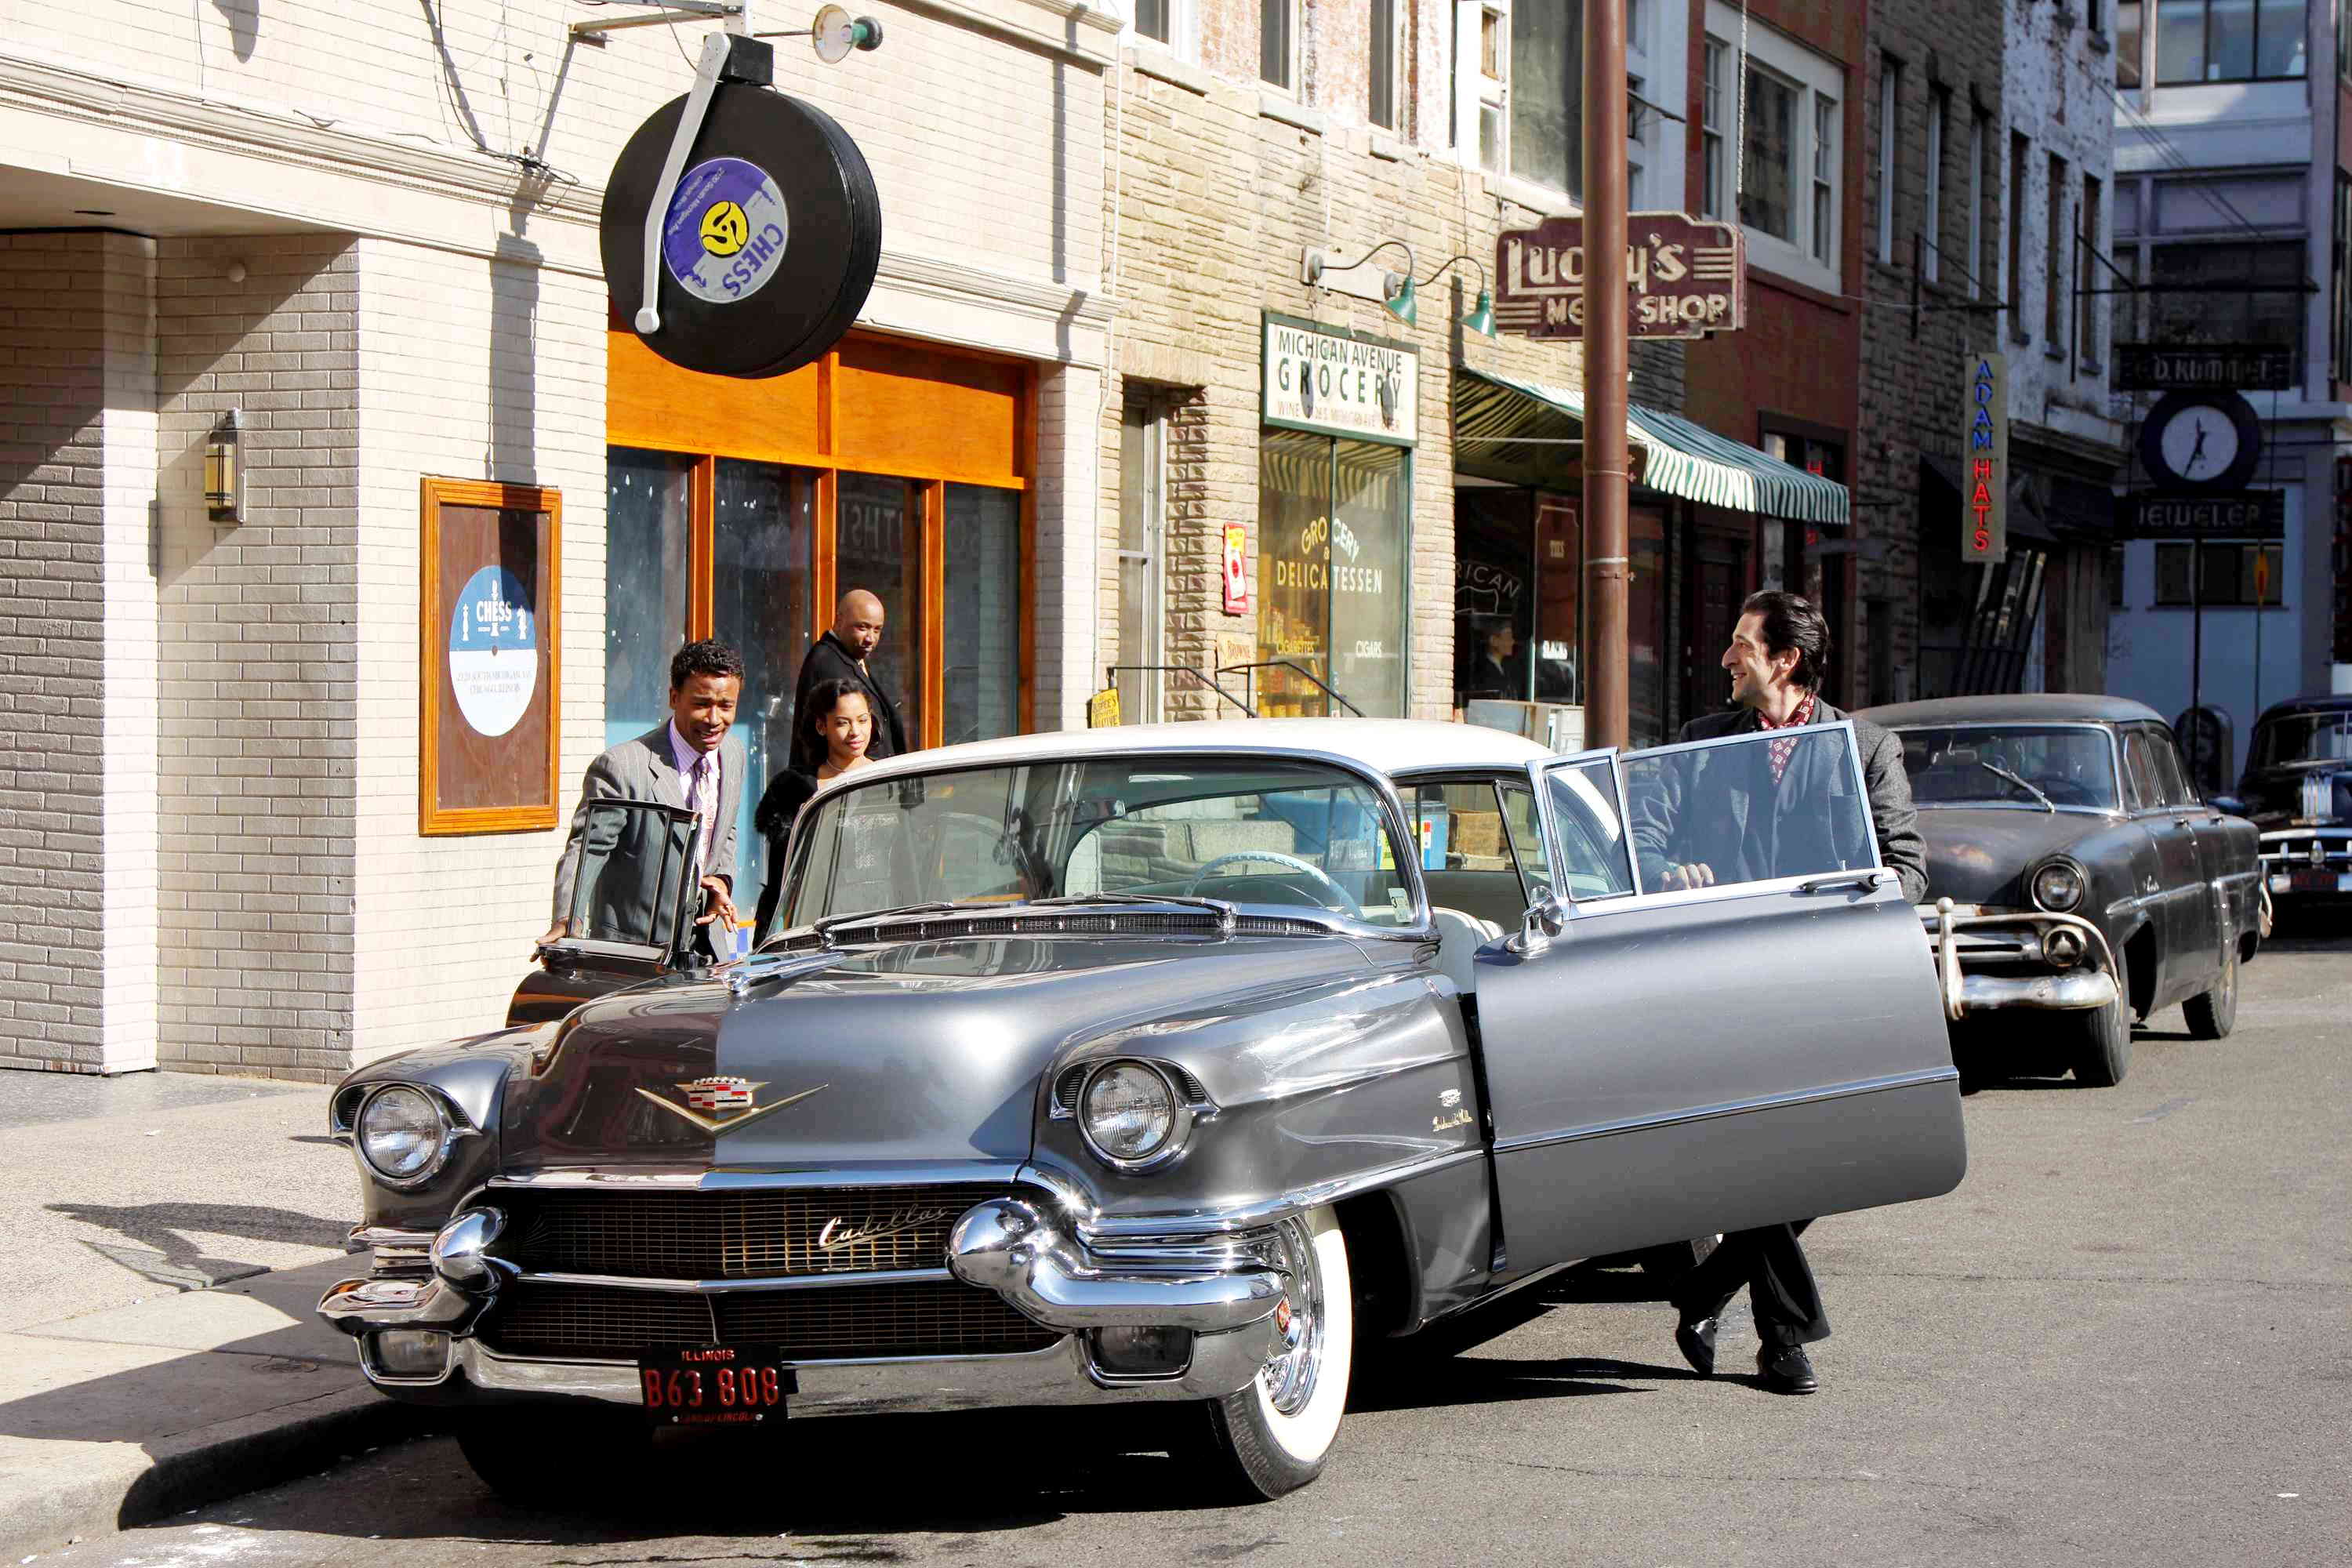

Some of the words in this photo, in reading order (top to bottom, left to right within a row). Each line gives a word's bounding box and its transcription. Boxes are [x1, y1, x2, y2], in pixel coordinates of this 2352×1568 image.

[722, 223, 785, 296] CHESS
[1636, 293, 1727, 324] SHOP
[1279, 330, 1348, 364] MICHIGAN
[1352, 344, 1402, 375] AVENUE
[1279, 357, 1401, 409] GROCERY
[1973, 360, 1994, 449] ADAM
[1973, 458, 1992, 550] HATS
[477, 601, 512, 622] CHESS
[1356, 641, 1382, 658] CIGARS
[818, 1203, 948, 1250] Cadillac
[681, 1350, 735, 1361] ILLINOIS
[644, 1369, 702, 1406] B63
[718, 1367, 779, 1406] 808
